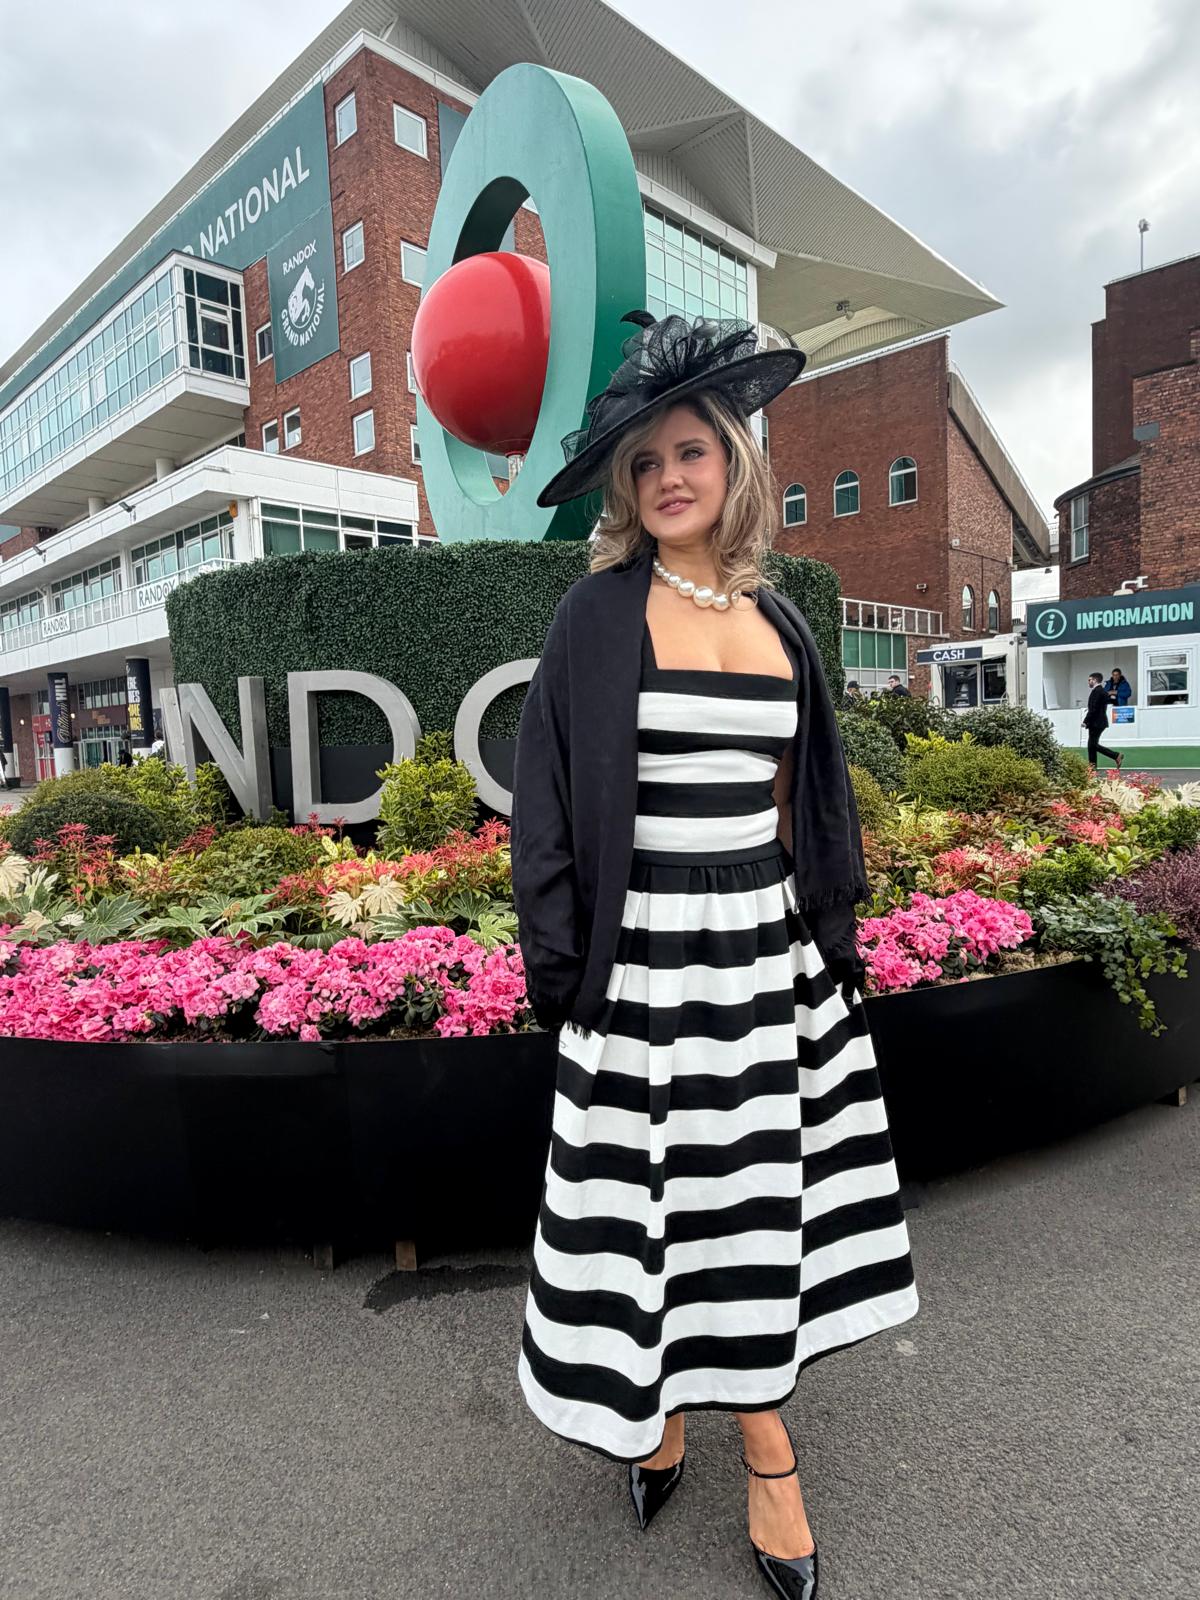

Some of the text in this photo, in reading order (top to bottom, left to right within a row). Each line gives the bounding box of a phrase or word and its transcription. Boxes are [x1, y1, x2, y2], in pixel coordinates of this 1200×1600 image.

[199, 146, 310, 260] NATIONAL
[282, 239, 317, 276] RANDOX
[281, 280, 325, 347] GRAND NATIONAL
[43, 614, 69, 635] RANDOX
[1076, 601, 1194, 631] INFORMATION
[932, 649, 966, 661] CASH
[54, 677, 68, 701] HILL
